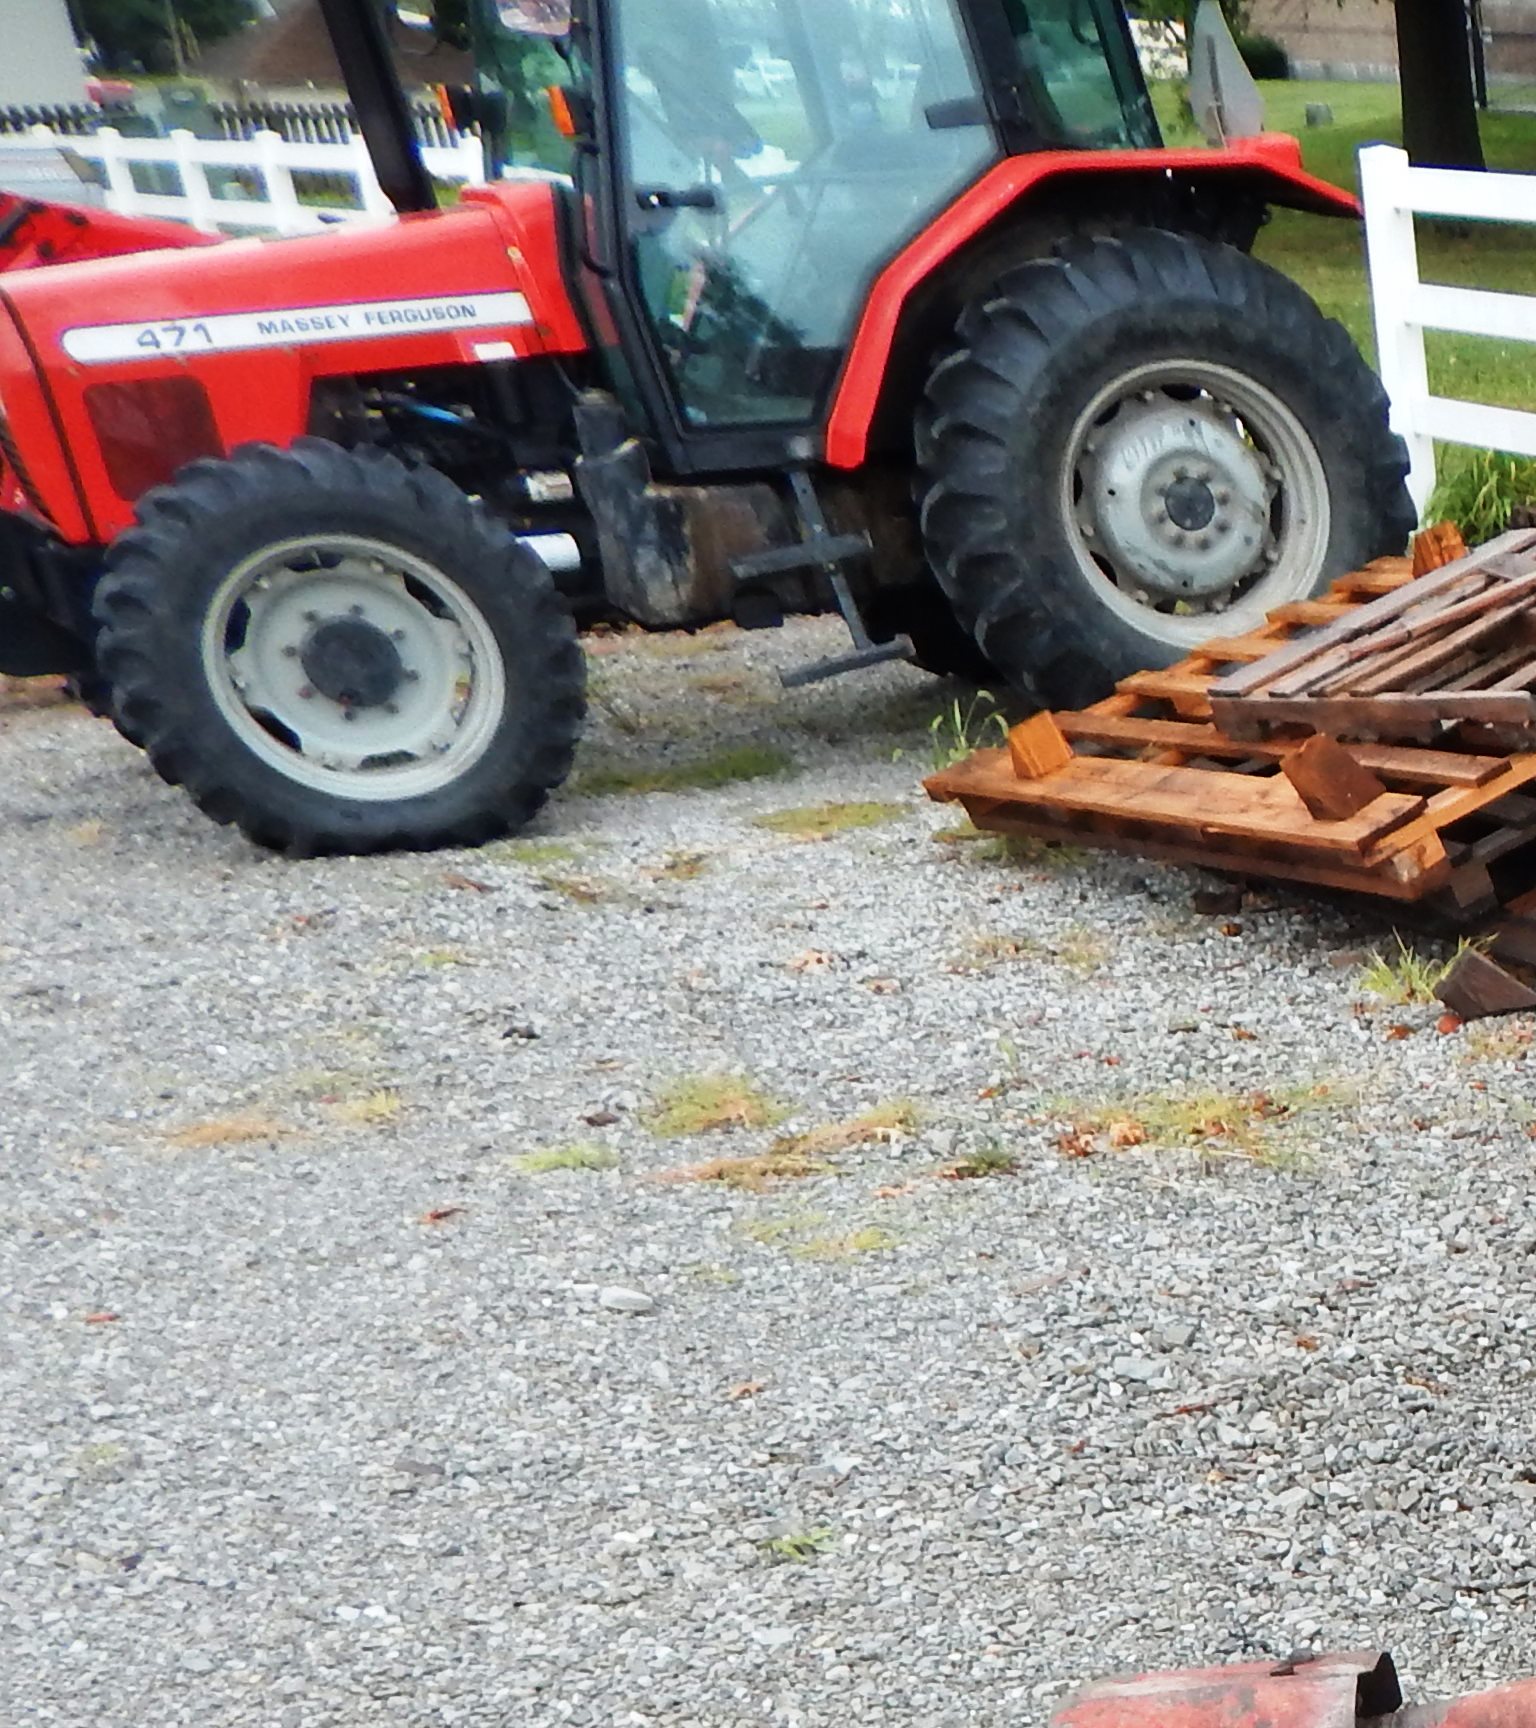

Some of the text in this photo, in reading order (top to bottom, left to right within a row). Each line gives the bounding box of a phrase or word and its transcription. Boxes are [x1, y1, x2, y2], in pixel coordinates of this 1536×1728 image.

[136, 304, 477, 350] 471 MASSEY FERGUSON
